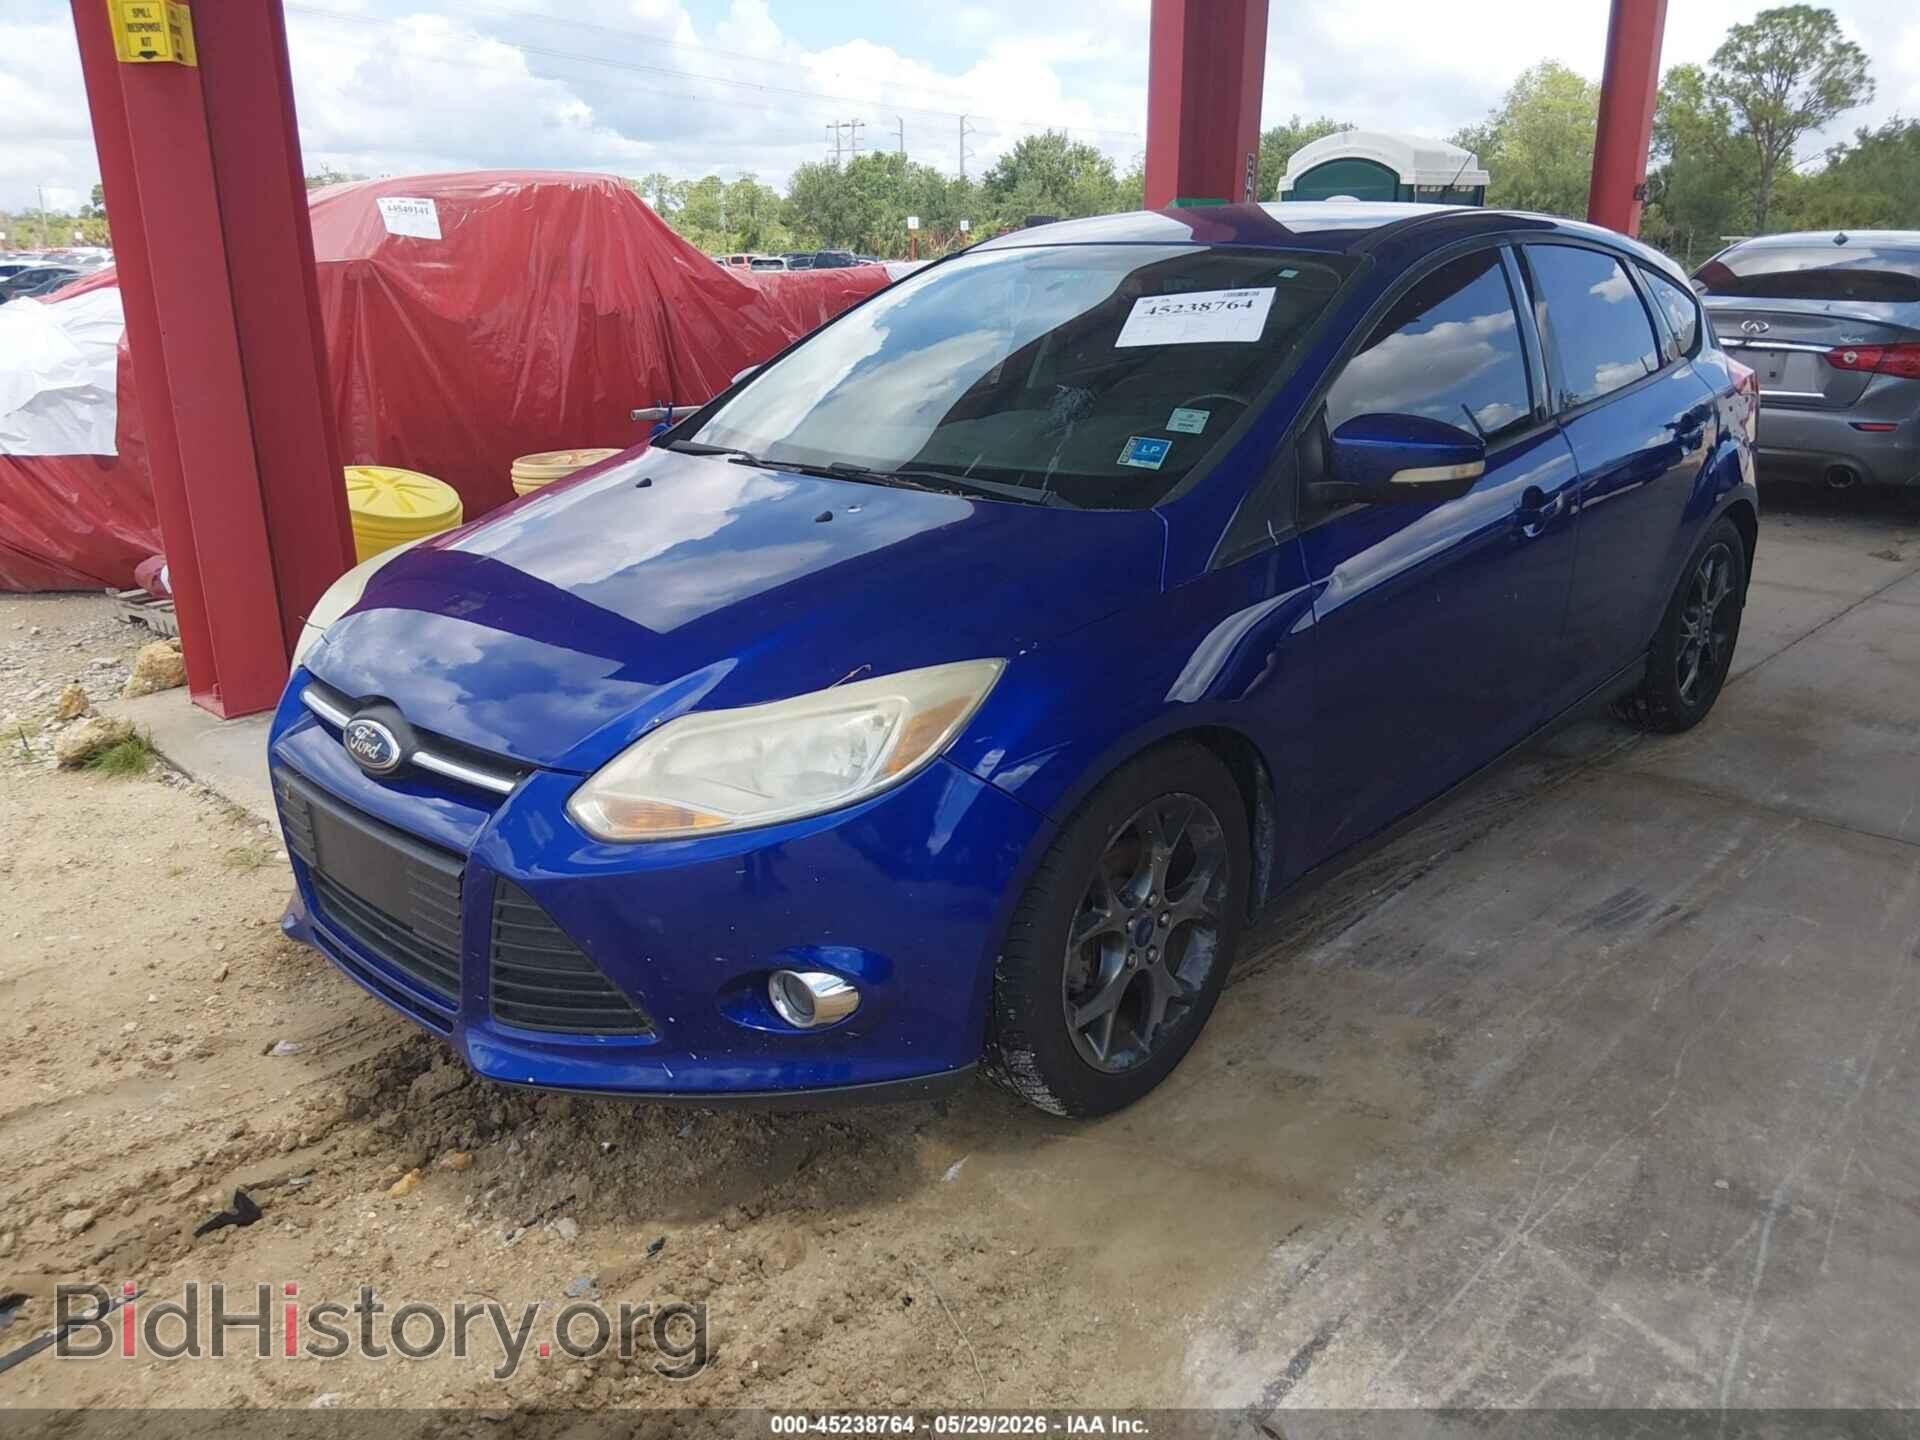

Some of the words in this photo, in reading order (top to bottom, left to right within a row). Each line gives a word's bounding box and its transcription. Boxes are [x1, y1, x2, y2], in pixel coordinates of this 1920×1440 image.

[131, 8, 152, 17] SPILL
[127, 22, 161, 32] RESPONSE
[140, 36, 152, 47] KIT
[1144, 299, 1253, 315] 45238764
[350, 726, 382, 759] Ford
